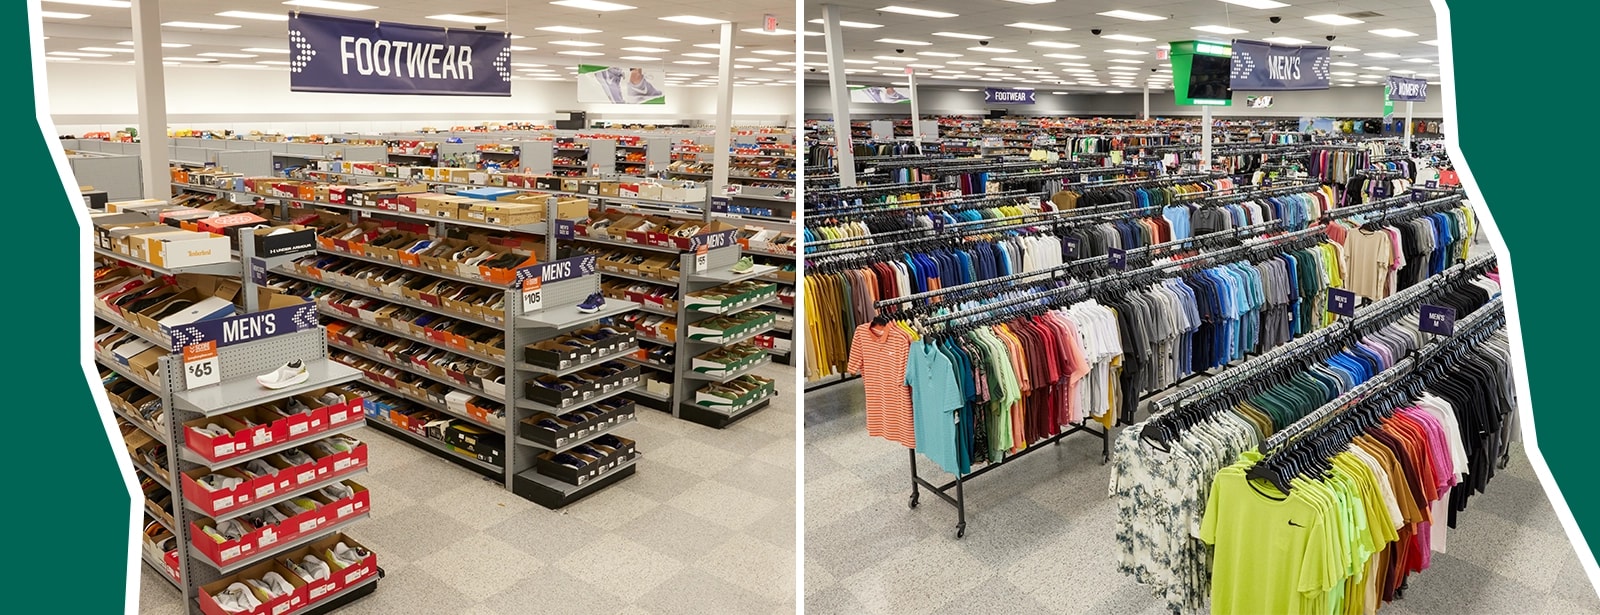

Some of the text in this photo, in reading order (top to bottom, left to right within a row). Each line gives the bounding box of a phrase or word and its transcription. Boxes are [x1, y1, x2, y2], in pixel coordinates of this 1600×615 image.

[340, 36, 473, 79] FOOTWEAR
[1268, 55, 1301, 80] MEN'S
[995, 91, 1026, 101] FOOTWEAR
[707, 233, 724, 248] MEN'S
[541, 261, 571, 282] MEN'S
[524, 290, 541, 303] $105
[1334, 295, 1348, 303] MEN'S
[1428, 312, 1445, 321] MEN'S
[223, 313, 276, 343] MEN'S
[189, 362, 212, 377] $65
